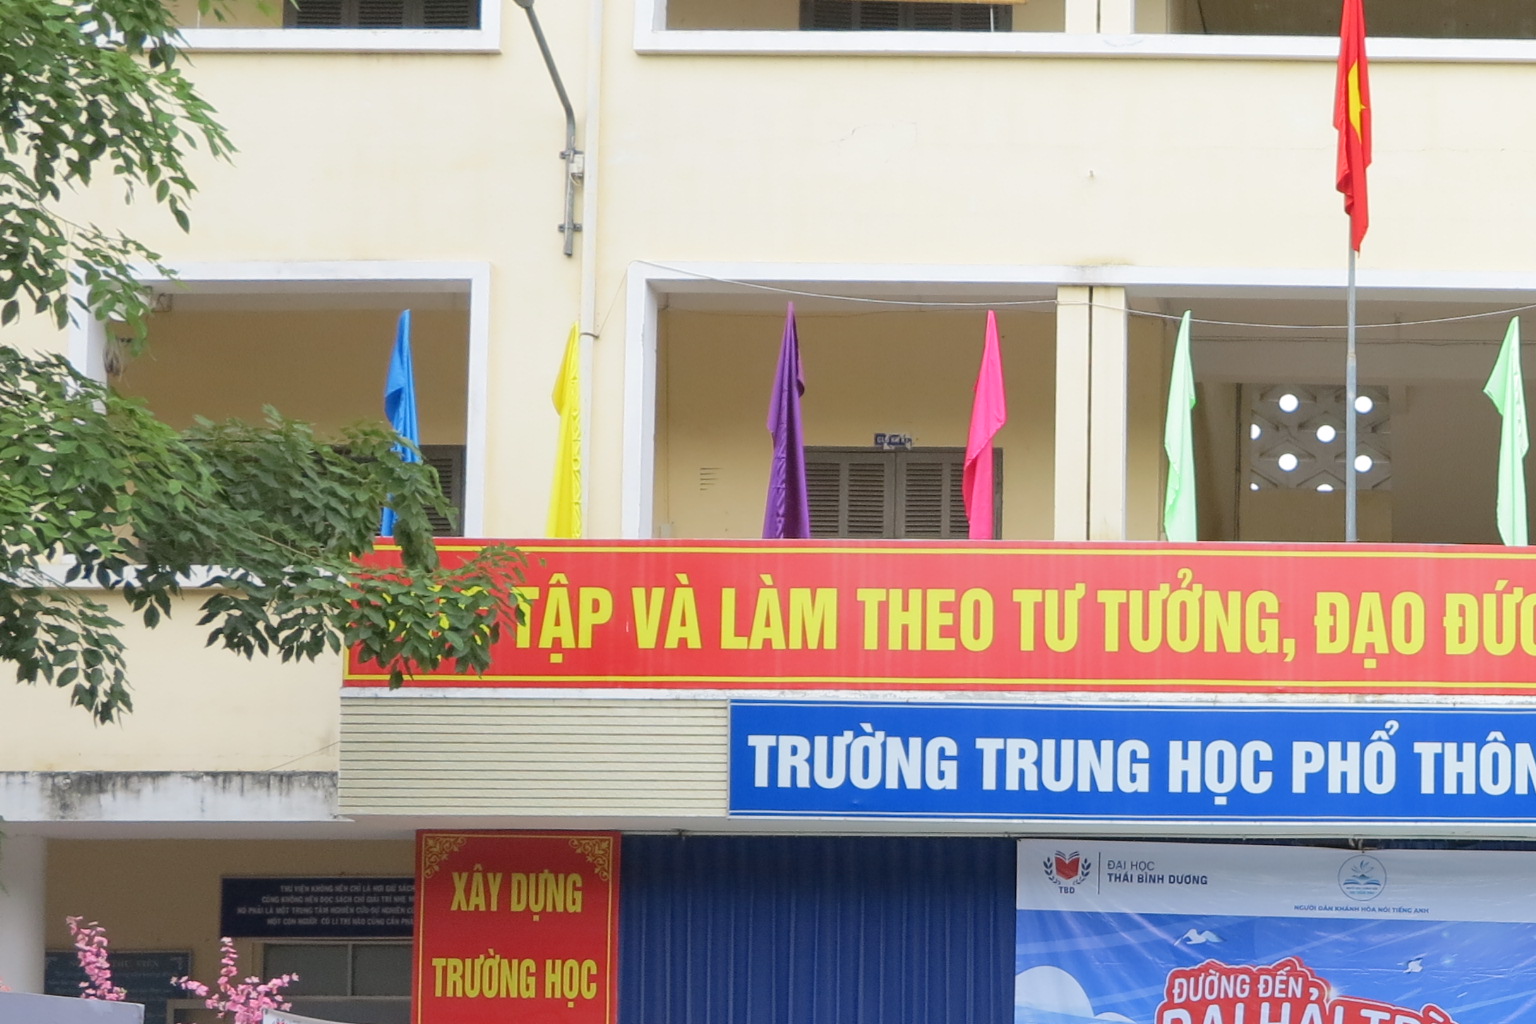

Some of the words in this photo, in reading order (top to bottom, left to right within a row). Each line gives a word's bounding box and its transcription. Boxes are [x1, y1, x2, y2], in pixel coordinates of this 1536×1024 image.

[514, 573, 612, 664] TẬP
[631, 574, 702, 650] VÀ
[720, 574, 838, 652] LÀM
[857, 588, 994, 652] THEO
[1012, 583, 1086, 654] TƯ
[1097, 567, 1297, 662] TƯỞNG,
[1314, 591, 1425, 669] ĐẠO
[747, 722, 958, 791] TRƯỜNG
[975, 737, 1150, 793] TRUNG
[1168, 739, 1273, 806] HỌC
[1291, 720, 1399, 795] PHỔ
[451, 864, 502, 912] XÂY
[511, 868, 583, 922] DỰNG
[1107, 871, 1134, 884] THÁI
[1137, 871, 1165, 885] BÌNH
[1168, 873, 1208, 886] DƯƠNG
[432, 948, 536, 999] TRƯỜNG
[545, 958, 597, 1008] HỌC
[1172, 969, 1251, 1003] ĐƯỜNG
[1257, 966, 1303, 999] ĐẾN
